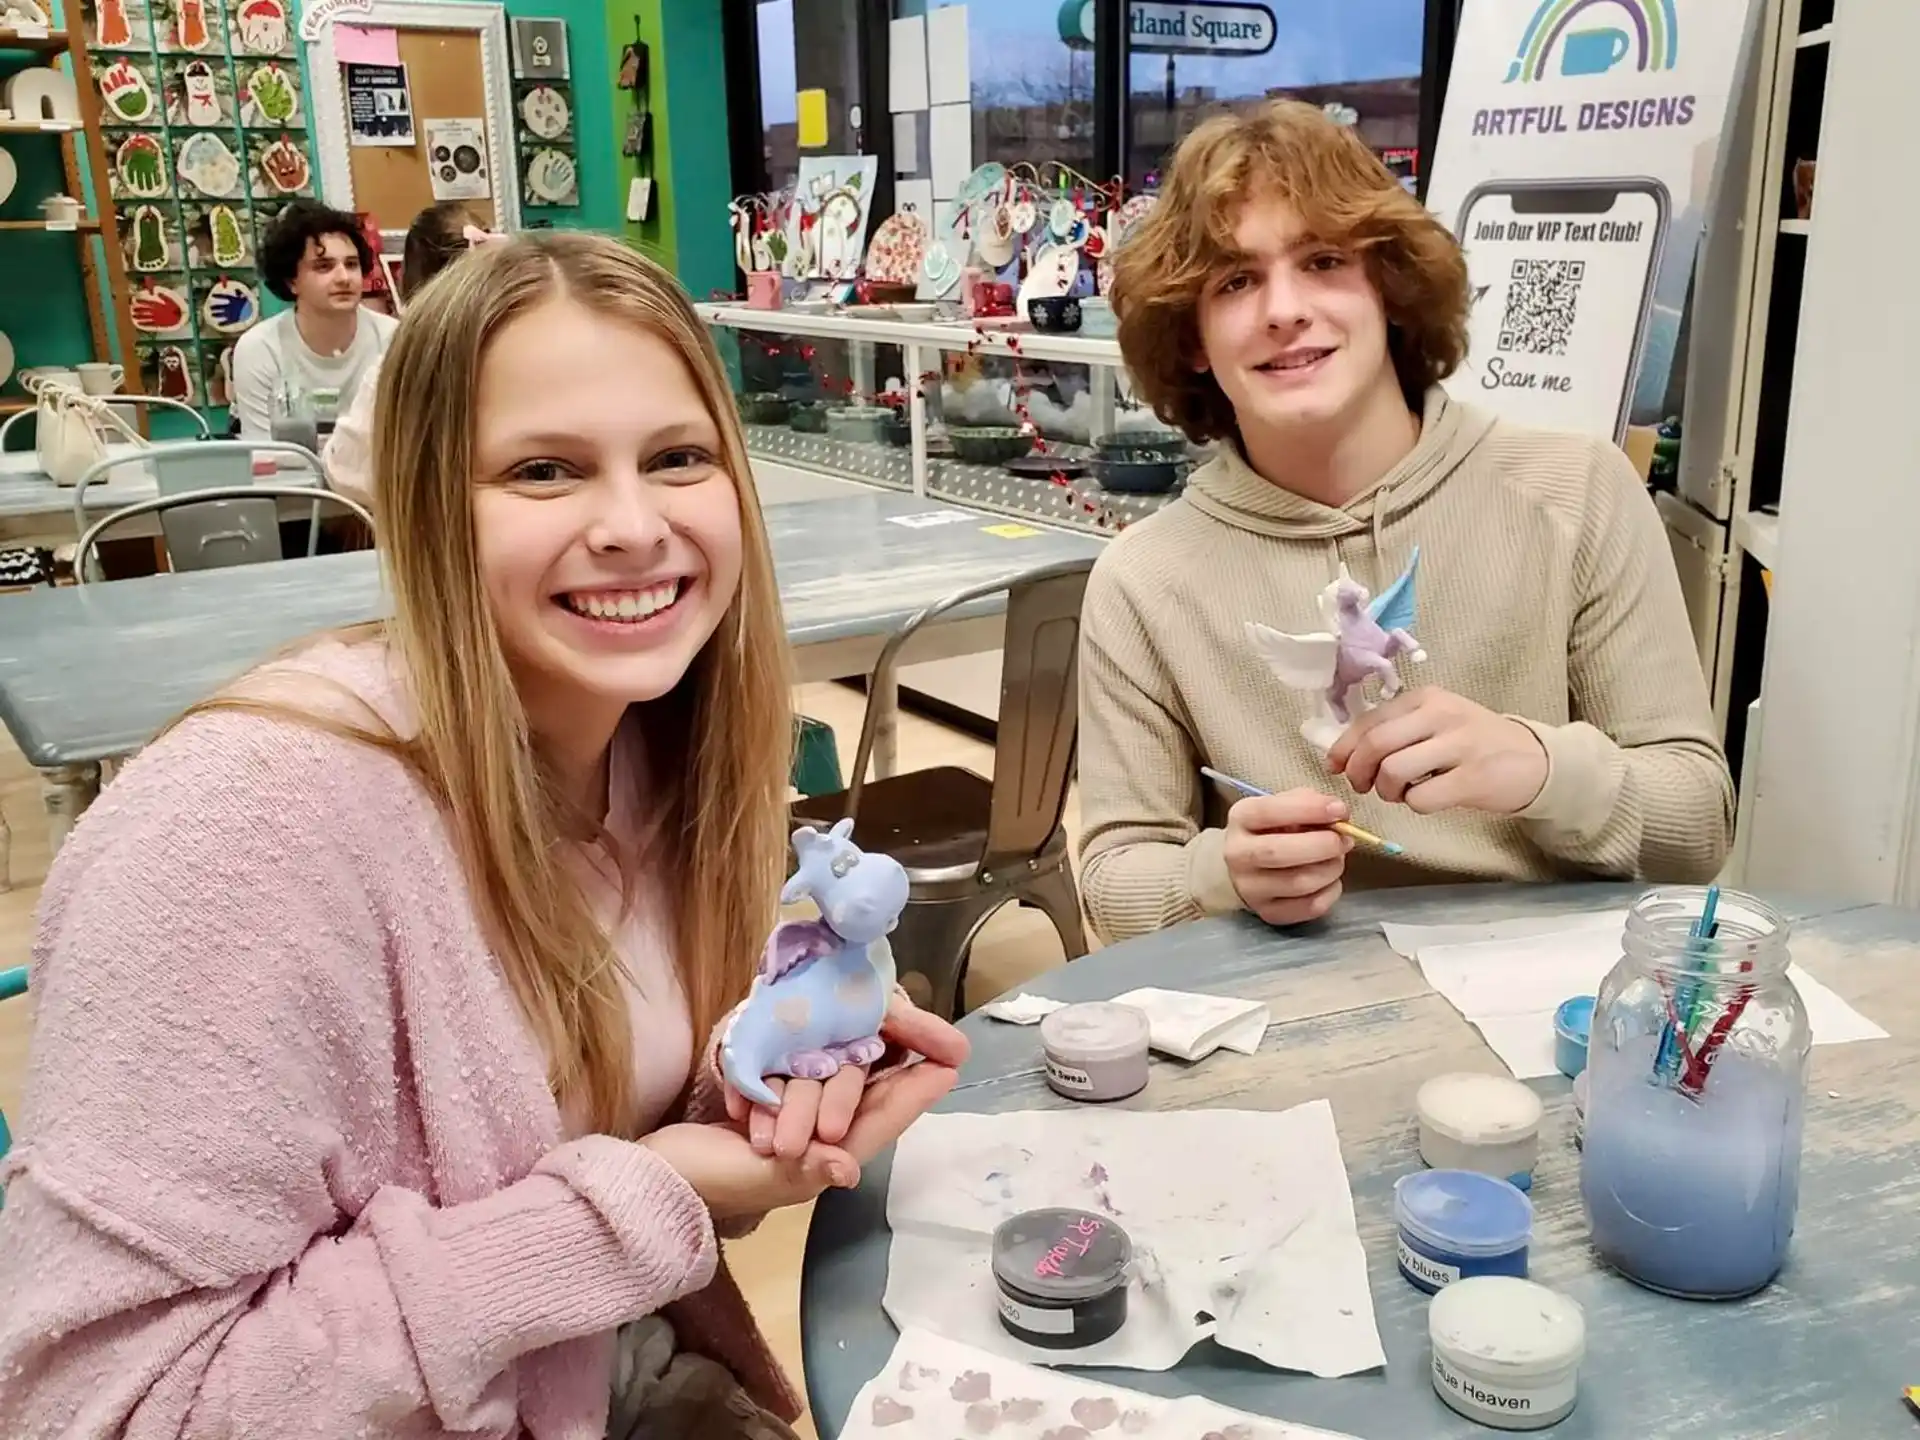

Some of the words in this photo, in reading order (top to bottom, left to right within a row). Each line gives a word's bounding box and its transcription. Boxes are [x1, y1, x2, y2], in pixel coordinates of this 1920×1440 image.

[1130, 8, 1186, 36] tland
[1191, 14, 1262, 44] Square
[1472, 105, 1567, 136] ARTFUL
[1577, 95, 1696, 131] DESIGNS
[1474, 220, 1505, 241] Join
[1507, 221, 1534, 241] Our
[1536, 221, 1561, 242] VIP
[1564, 221, 1596, 242] Text
[1599, 221, 1643, 242] Club!
[1481, 356, 1537, 389] Scan
[1541, 374, 1572, 392] me
[1412, 1257, 1450, 1284] blues
[1463, 1380, 1531, 1410] Heaven
